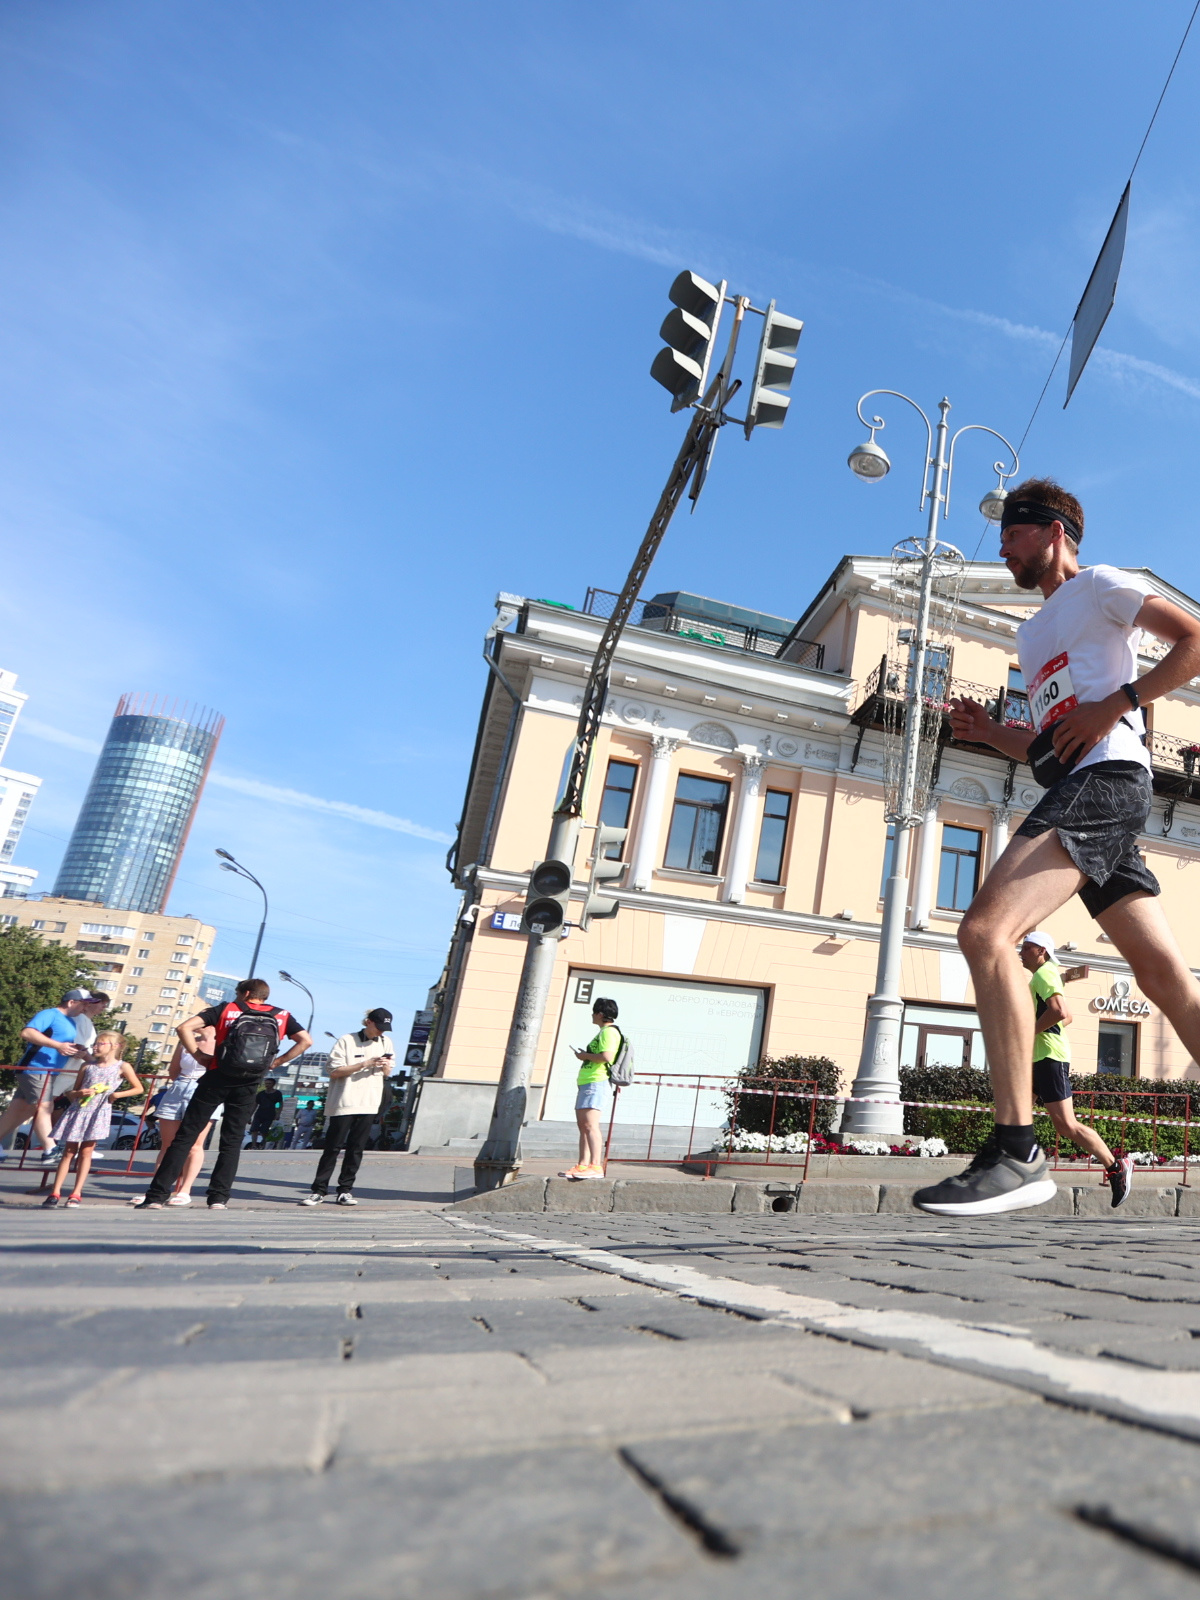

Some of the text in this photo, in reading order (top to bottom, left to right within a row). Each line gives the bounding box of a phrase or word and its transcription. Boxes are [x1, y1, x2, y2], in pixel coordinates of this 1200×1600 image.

[1035, 681, 1060, 717] 1160
[668, 994, 762, 1010] ДОБРО ПОЖАЛОВАТЬ
[1094, 996, 1152, 1015] OMEGA
[707, 1007, 714, 1016] В
